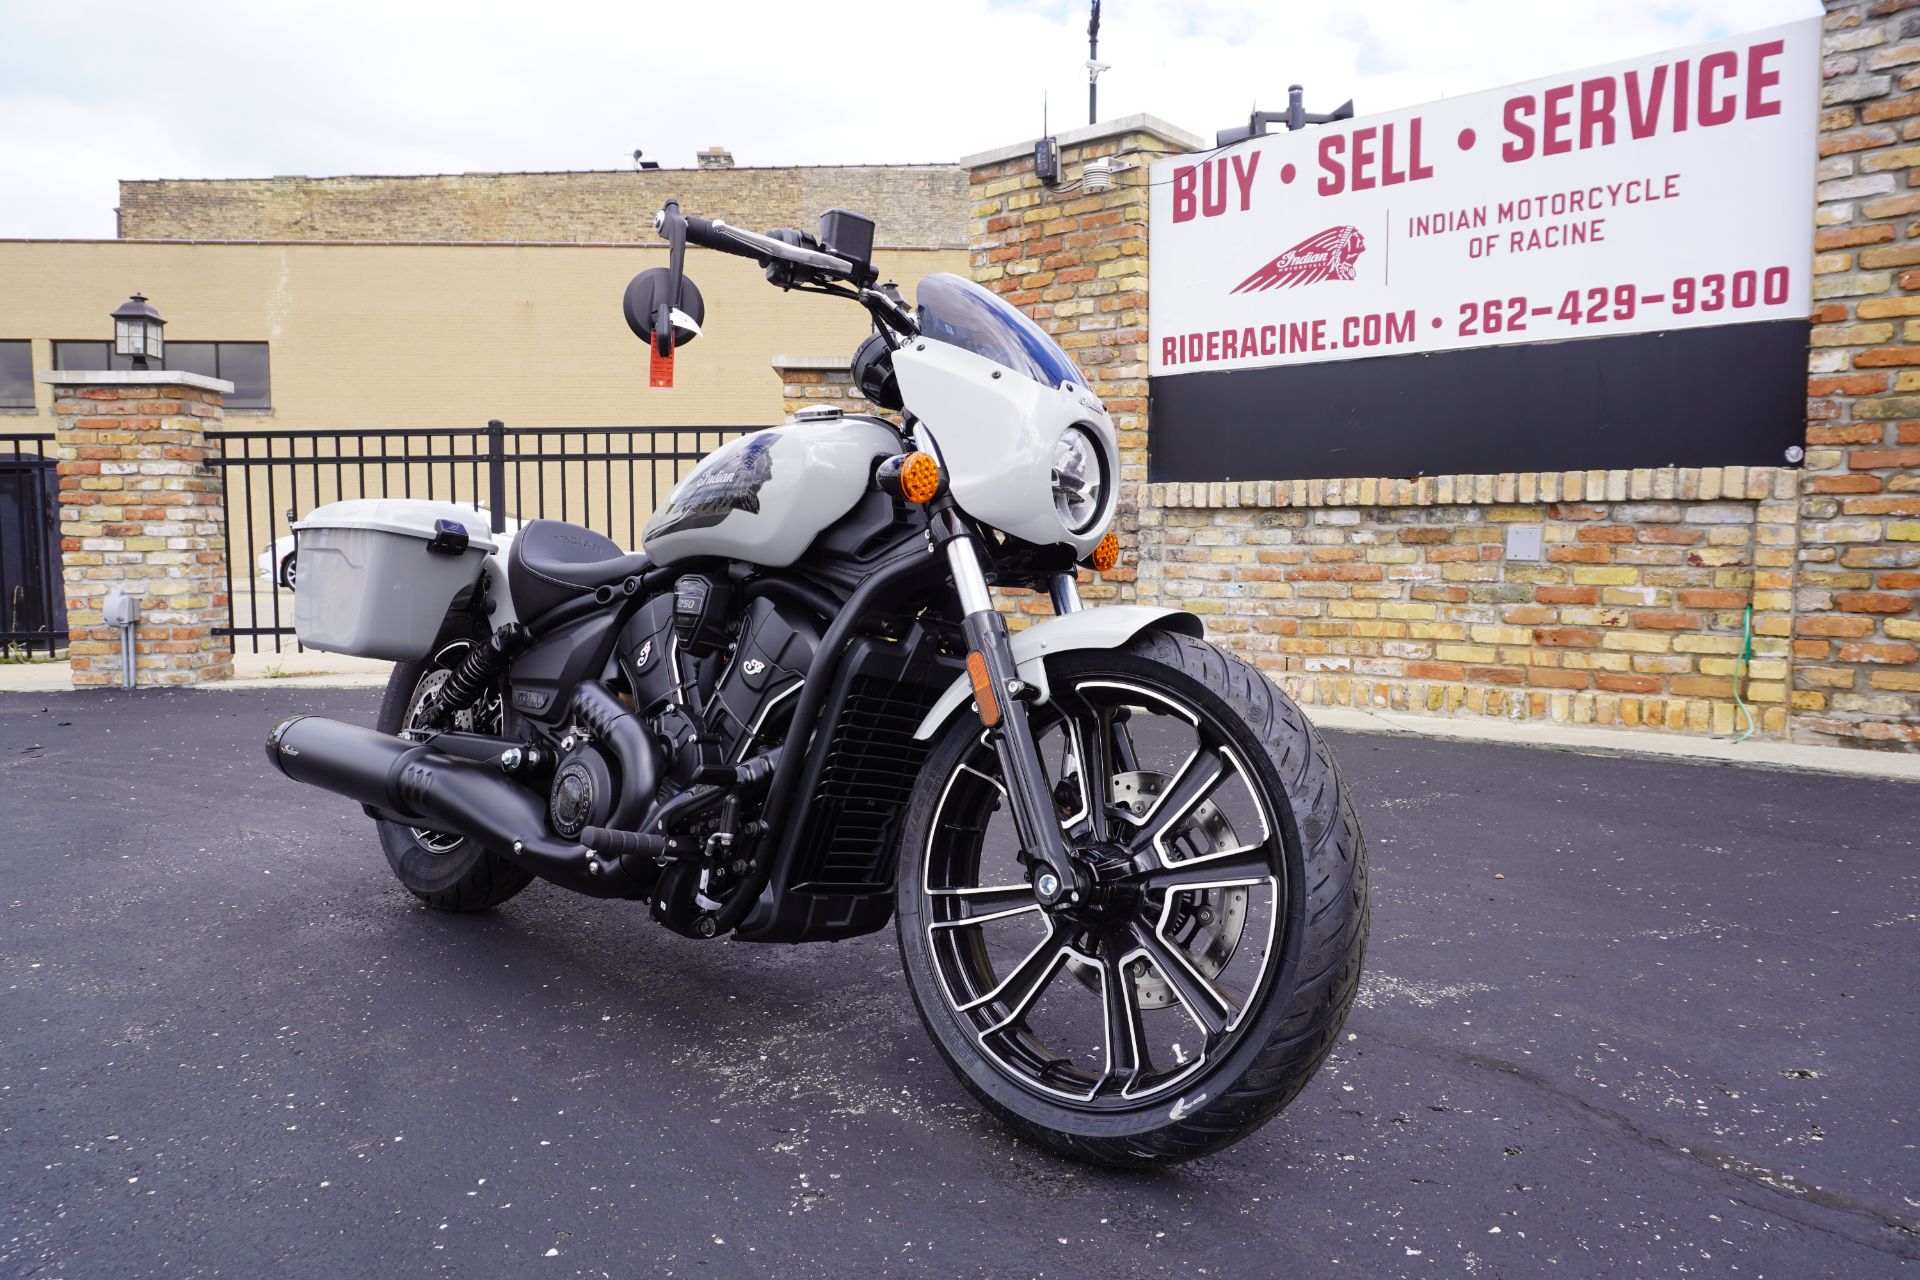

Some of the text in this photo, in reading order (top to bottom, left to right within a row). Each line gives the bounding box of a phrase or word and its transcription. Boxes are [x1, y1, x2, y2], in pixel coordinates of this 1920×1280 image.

[1172, 40, 1784, 224] BUY SELL SERVICE
[1409, 174, 1681, 239] INDIAN MOTORCYCLE
[1276, 250, 1329, 268] Indian
[1469, 219, 1605, 259] OF RACINE
[1162, 266, 1789, 366] RIDERACINE.COM 262-429-9300
[697, 470, 735, 487] Indian
